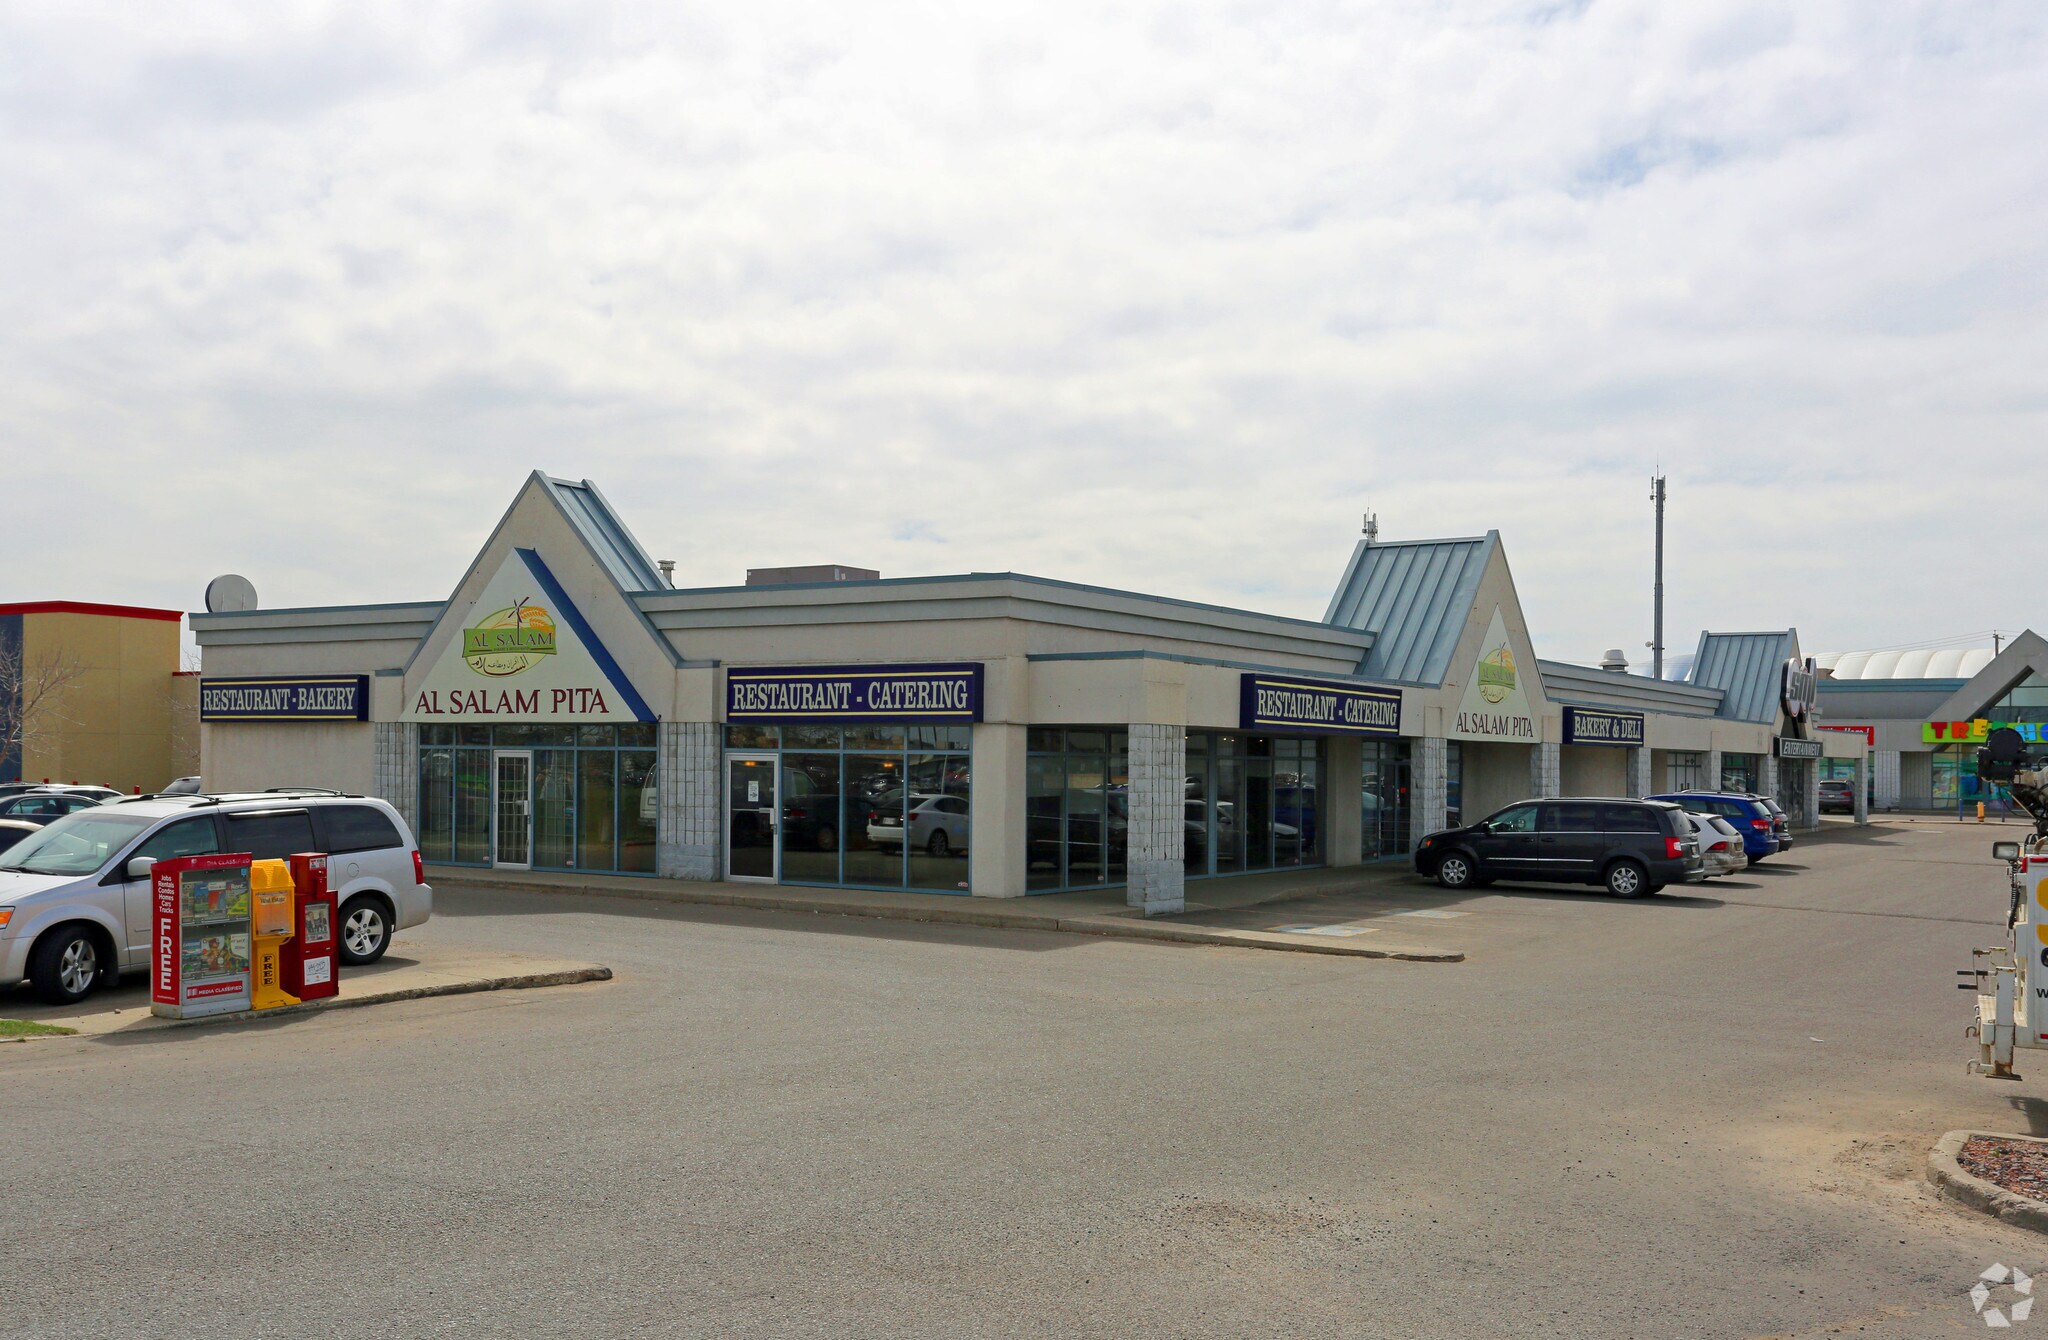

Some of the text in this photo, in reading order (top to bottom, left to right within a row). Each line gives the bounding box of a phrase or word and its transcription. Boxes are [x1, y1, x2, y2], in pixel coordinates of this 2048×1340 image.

[472, 632, 552, 647] AL SALAM
[203, 689, 290, 711] RESTAURANT
[298, 687, 356, 711] BAKERY
[415, 688, 610, 714] AL SALAM PITA
[733, 683, 852, 710] RESTAURANT
[867, 680, 968, 709] CATERING
[1257, 689, 1337, 721] RESTAURANT
[1344, 698, 1398, 726] CATERING
[1456, 711, 1534, 738] AL SALAM PITA
[1573, 716, 1642, 739] BAKERY & DELI
[1783, 741, 1820, 756] ENTERTAINMENT
[158, 880, 175, 888] Rentals
[158, 887, 175, 895] Condos
[159, 893, 174, 901] Homes
[159, 905, 174, 914] Trucks
[160, 918, 172, 991] FREE
[263, 955, 273, 985] FREE
[215, 985, 243, 993] CLASSIFIED
